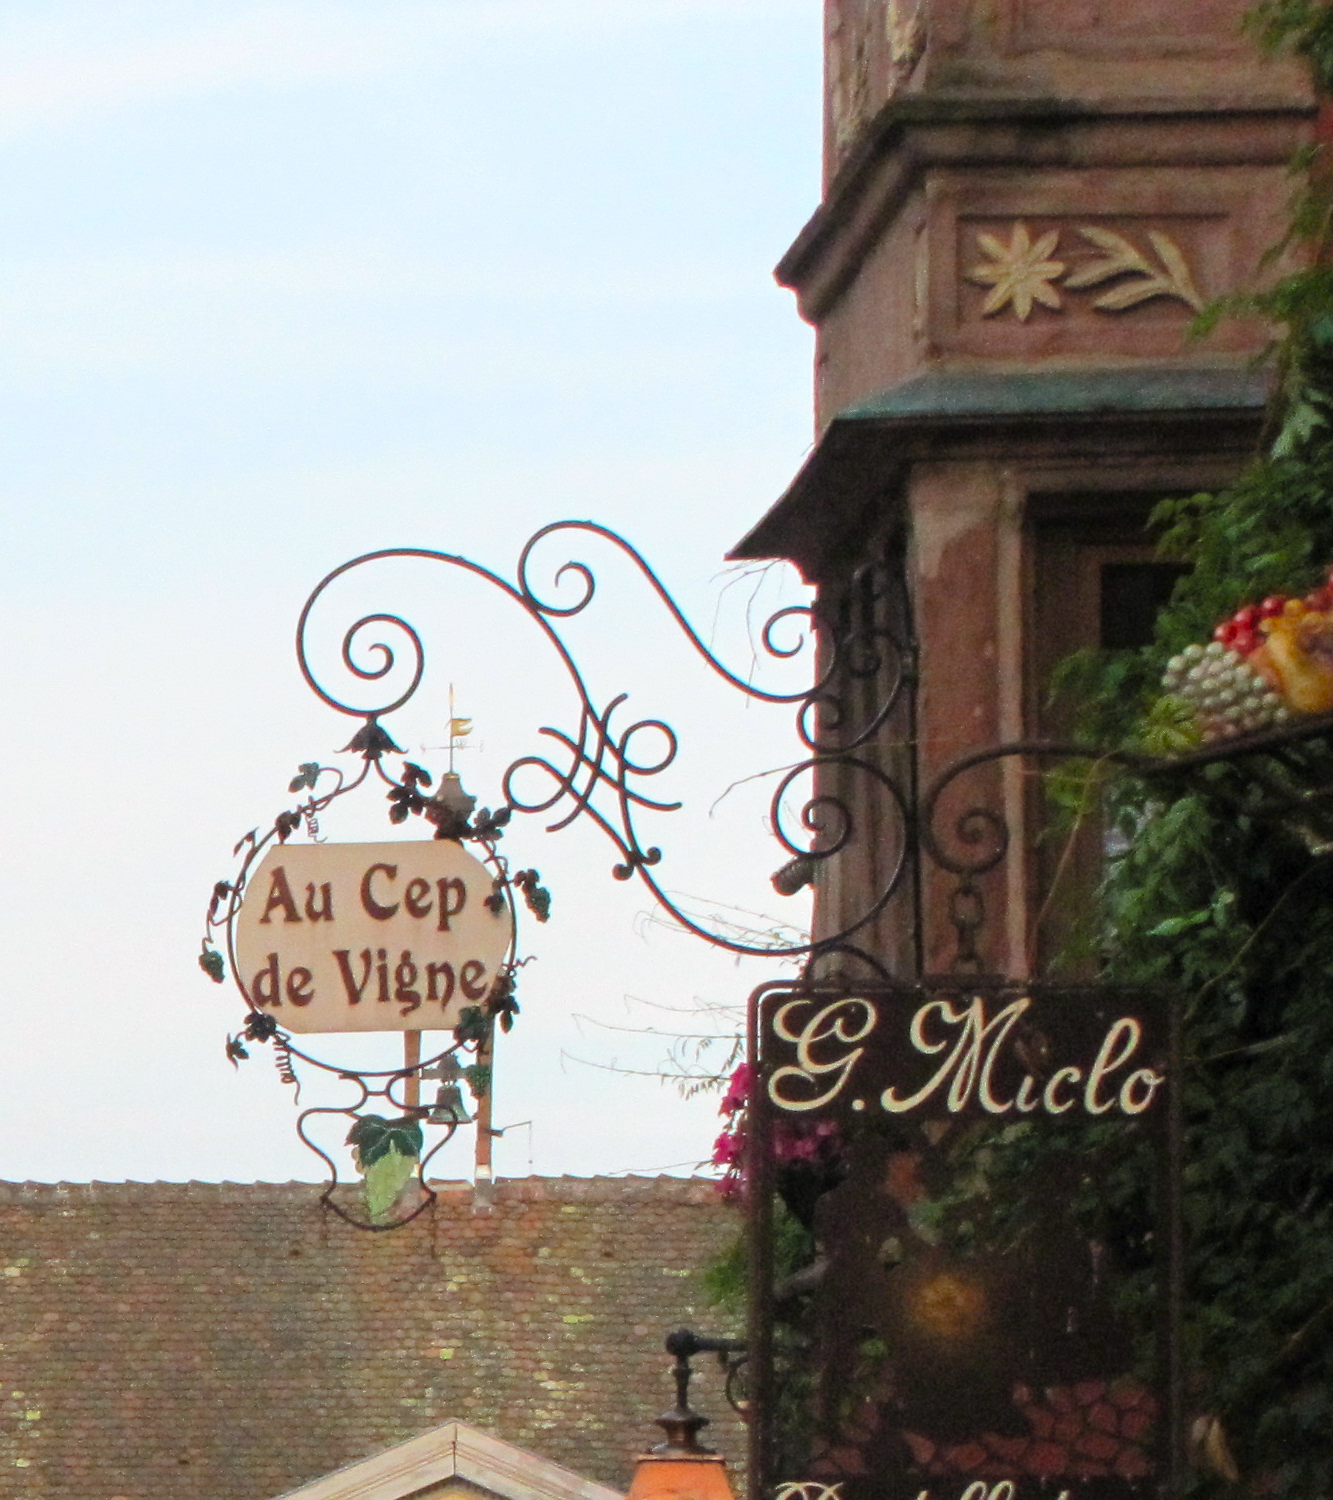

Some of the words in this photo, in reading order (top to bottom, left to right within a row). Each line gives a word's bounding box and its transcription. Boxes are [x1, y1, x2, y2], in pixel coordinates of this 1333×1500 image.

[259, 866, 334, 923] Au
[359, 862, 467, 932] Cep
[250, 952, 315, 1007] de
[331, 948, 487, 1018] Vigne
[767, 998, 877, 1112] G.
[880, 996, 1166, 1115] Miclo
